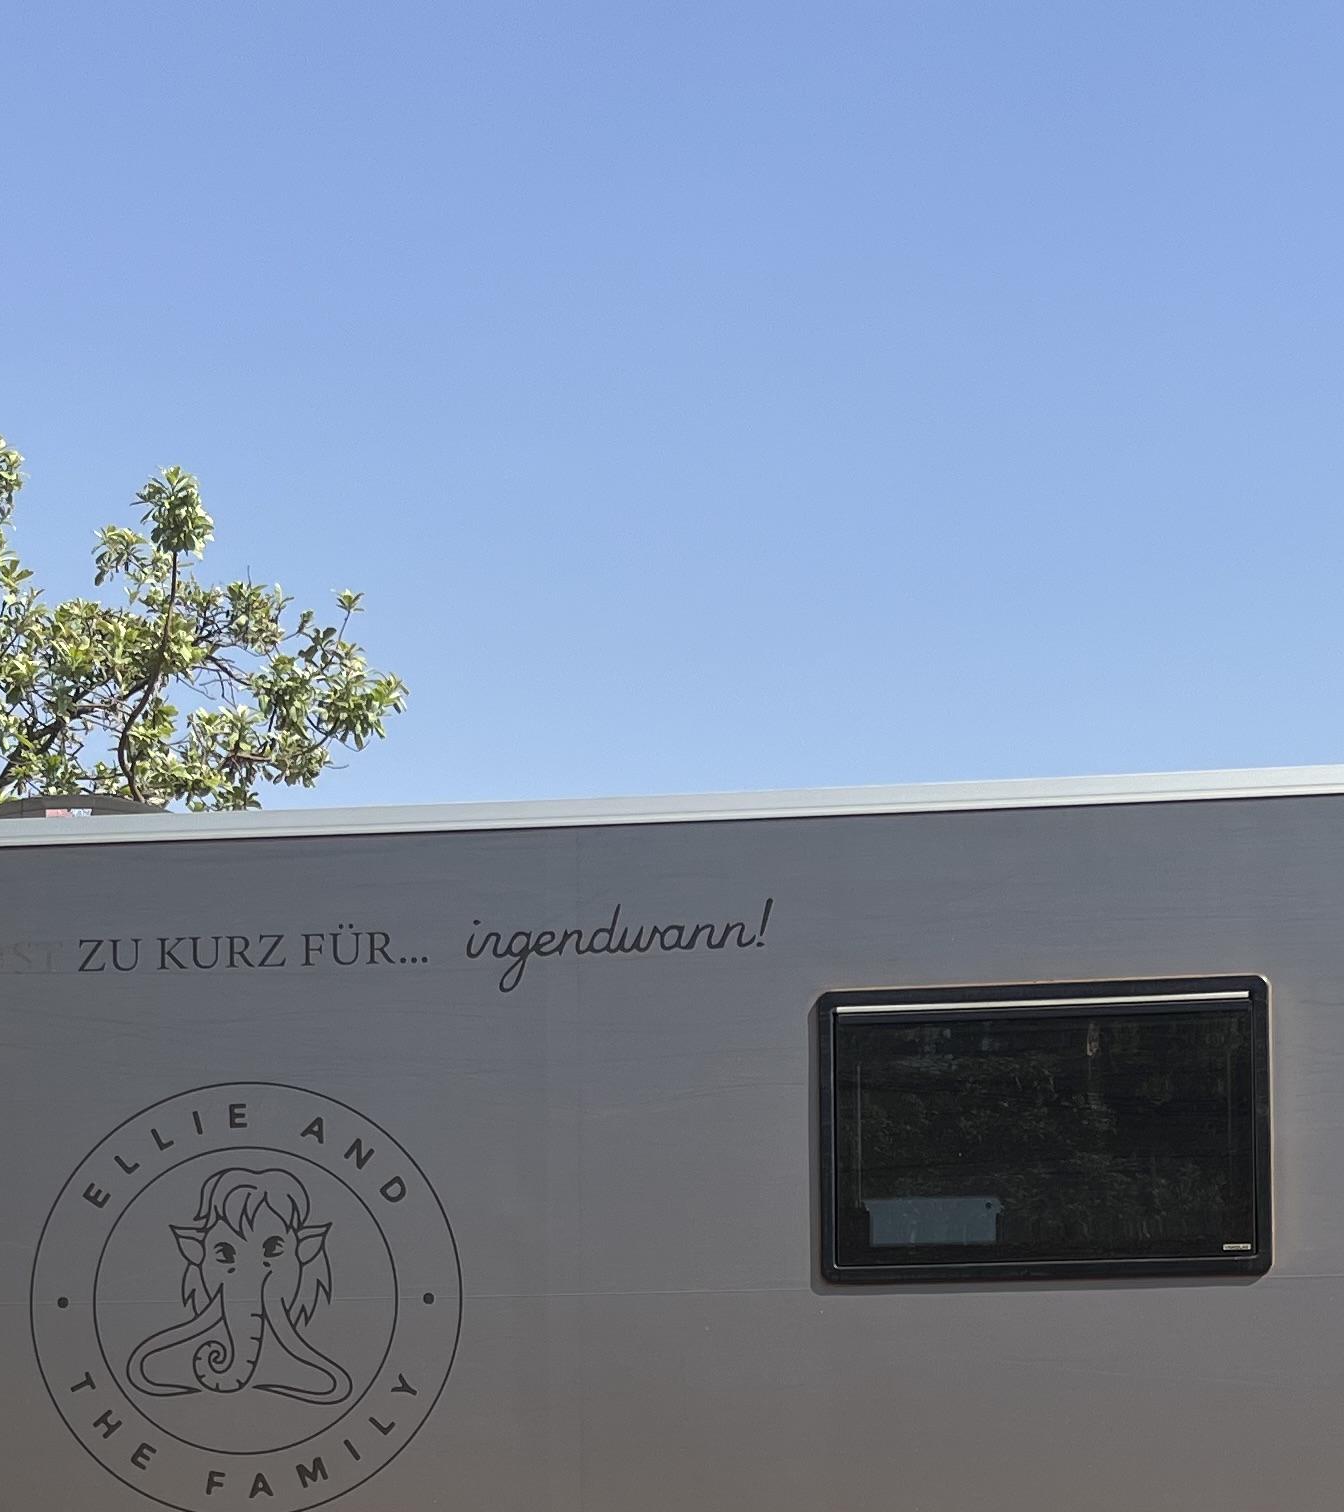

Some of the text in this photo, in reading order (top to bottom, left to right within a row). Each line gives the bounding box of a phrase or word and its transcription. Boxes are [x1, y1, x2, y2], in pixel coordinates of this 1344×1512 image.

[77, 897, 774, 993] ZU KURZ FÜR... irgendwann!
[82, 1103, 408, 1209] ELLIE AND
[69, 1371, 419, 1499] THE FAMILY
